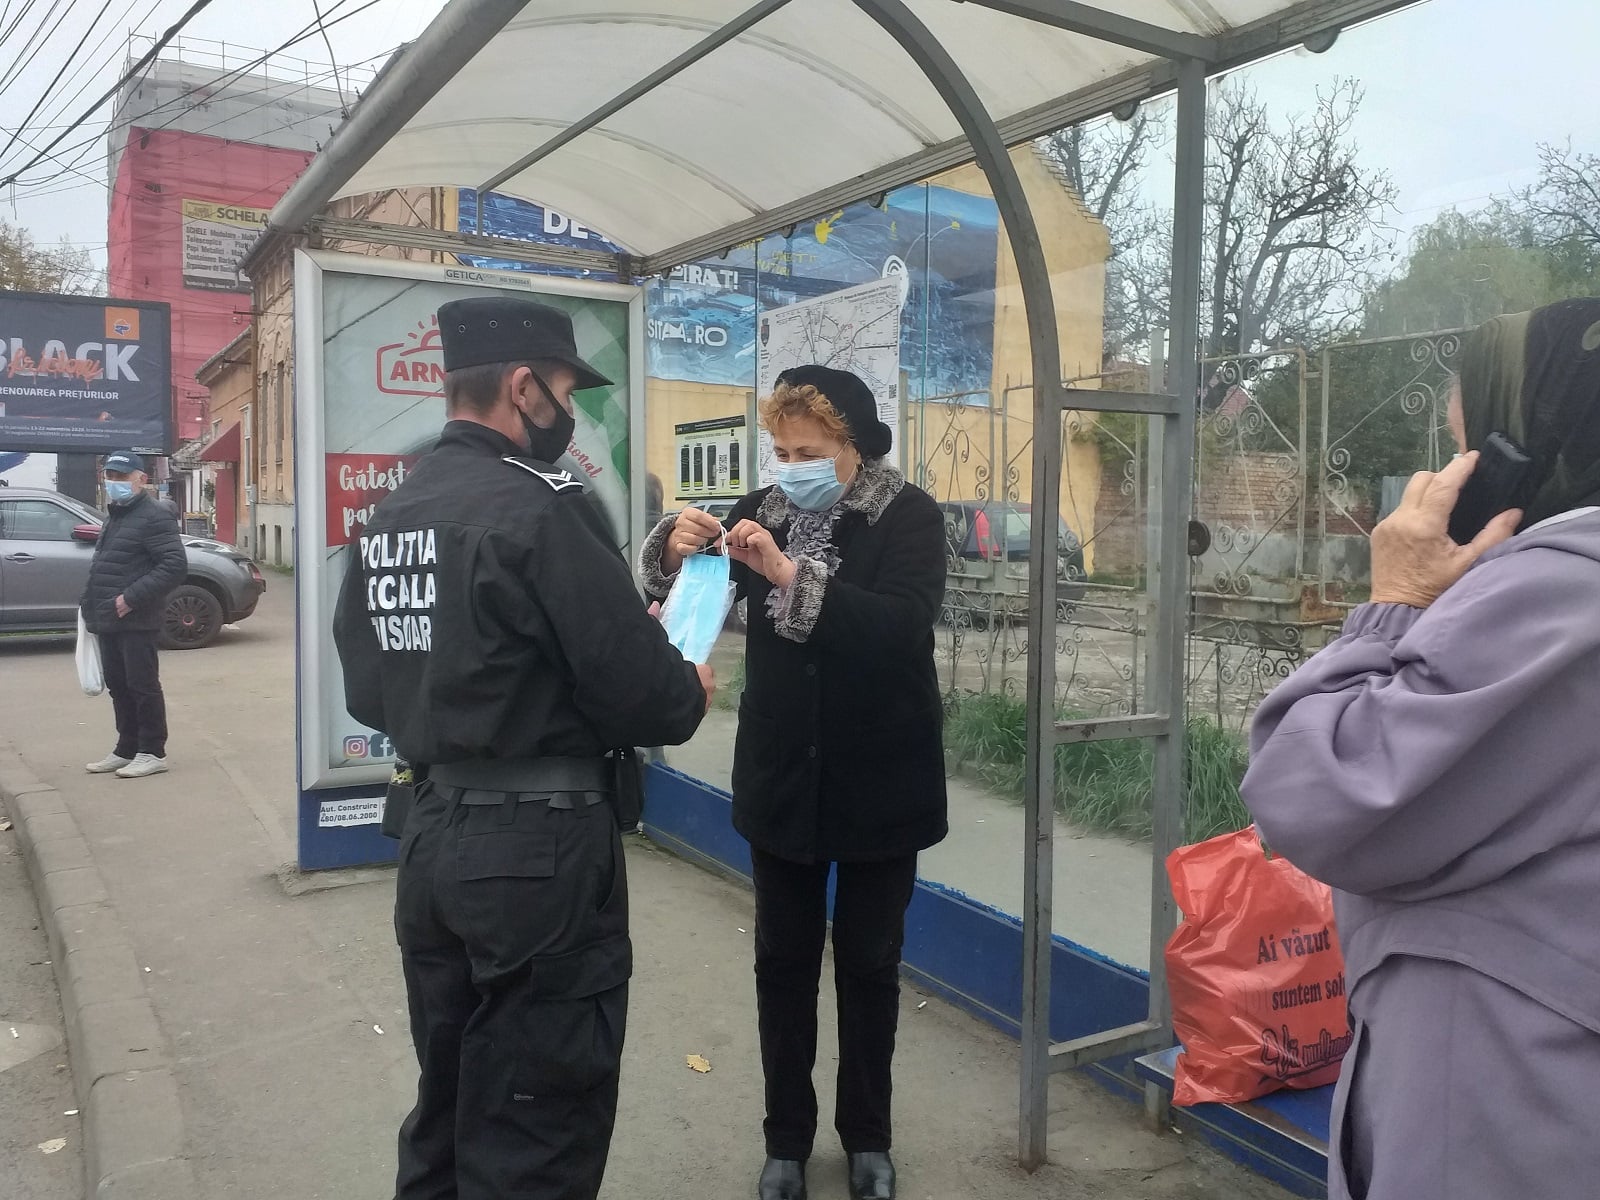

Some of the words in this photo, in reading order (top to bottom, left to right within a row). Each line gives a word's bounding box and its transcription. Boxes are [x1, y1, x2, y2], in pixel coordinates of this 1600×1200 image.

[446, 269, 483, 281] GETICA
[360, 528, 437, 570] POLITIA
[337, 802, 378, 812] Construire
[1257, 934, 1278, 964] Ai
[1271, 979, 1322, 1011] suntem
